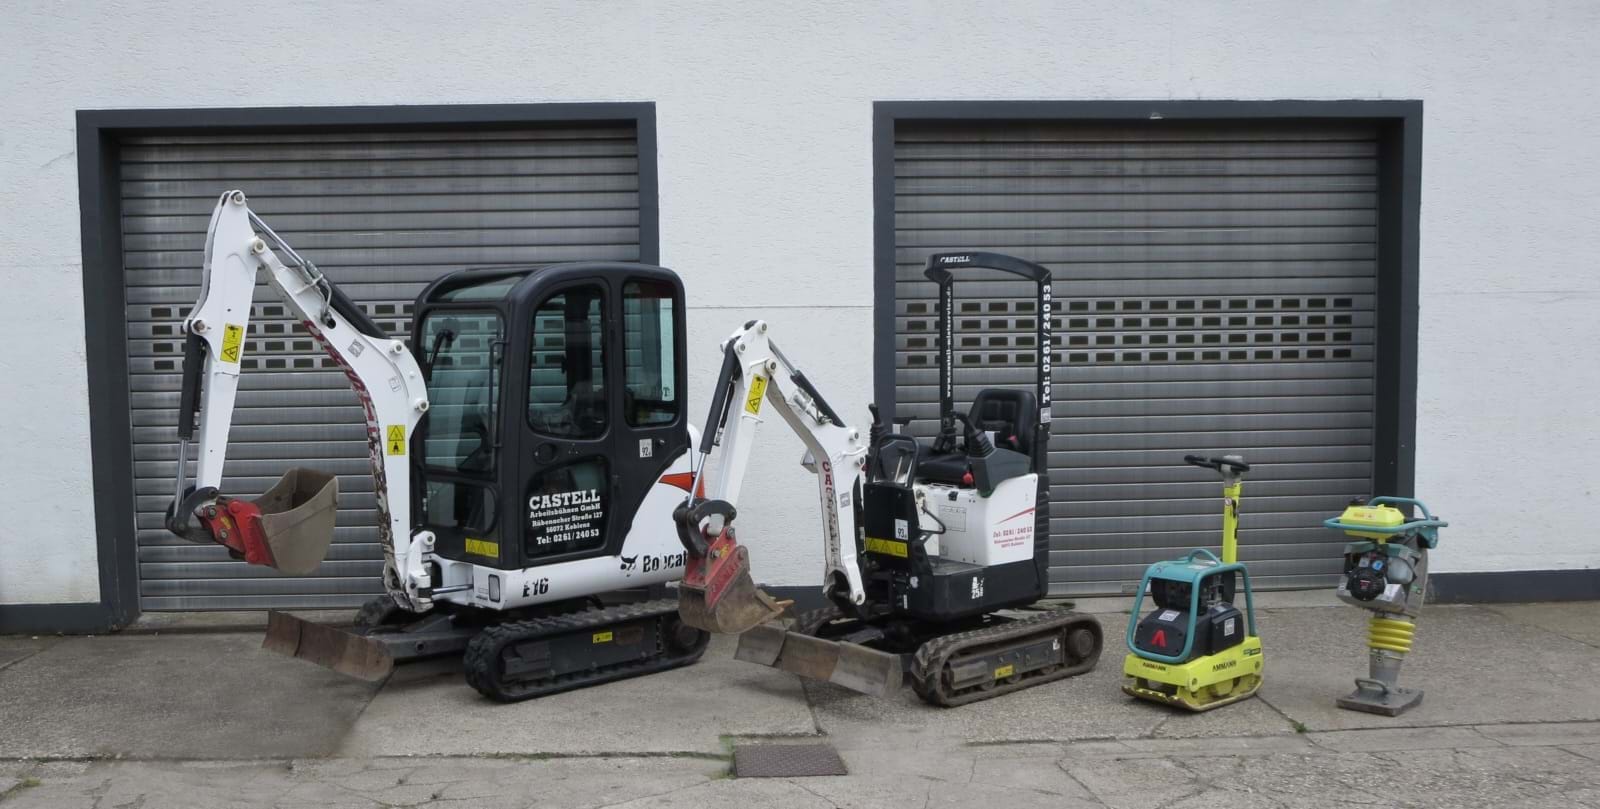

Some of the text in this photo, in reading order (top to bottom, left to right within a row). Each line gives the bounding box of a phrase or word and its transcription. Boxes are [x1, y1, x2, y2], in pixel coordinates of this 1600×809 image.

[1043, 376, 1051, 403] Tel:
[529, 489, 600, 510] CASTELL
[580, 502, 600, 511] GmbH
[565, 522, 590, 531] Koblenz
[536, 535, 552, 545] Tel:
